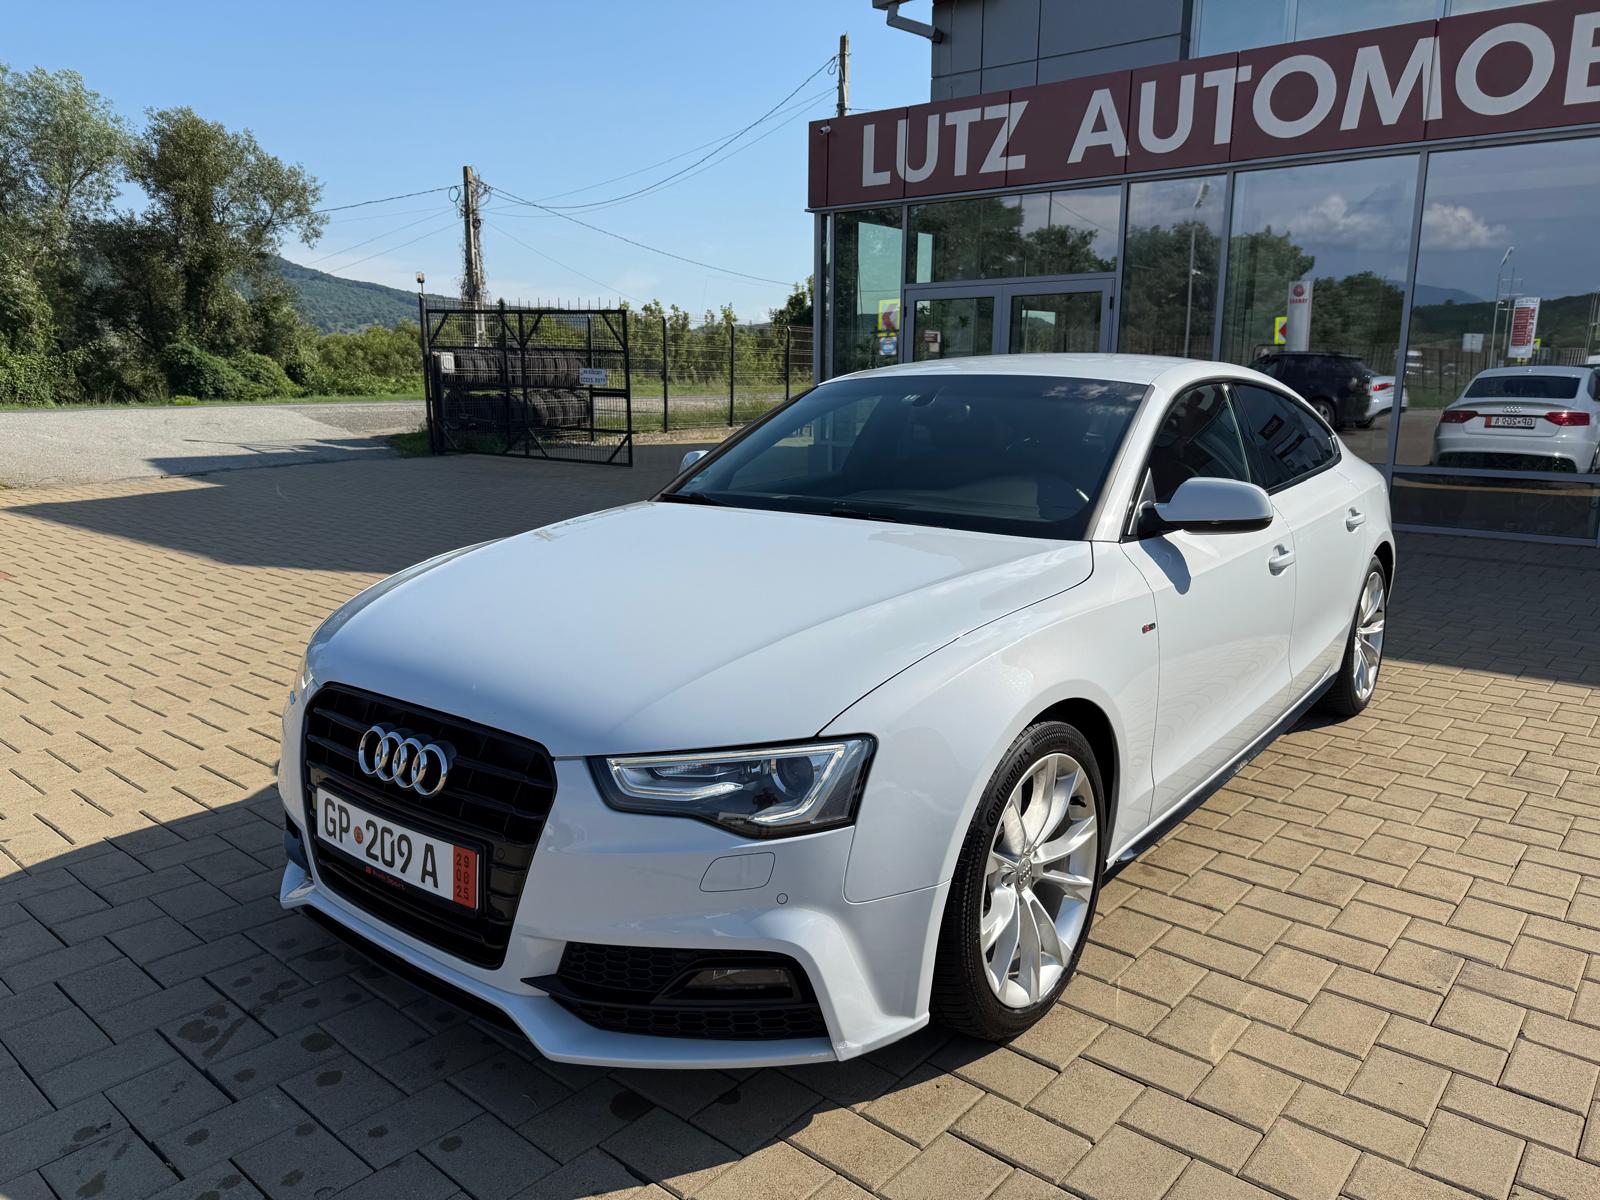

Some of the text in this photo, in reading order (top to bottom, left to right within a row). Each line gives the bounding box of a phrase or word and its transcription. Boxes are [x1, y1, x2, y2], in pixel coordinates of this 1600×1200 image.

[862, 100, 1029, 187] LUTZ
[986, 754, 1027, 827] Continental
[324, 798, 350, 844] GP
[365, 819, 413, 874] 209
[420, 842, 439, 889] A
[456, 853, 470, 868] 29
[455, 869, 470, 885] 08
[456, 885, 470, 900] 25
